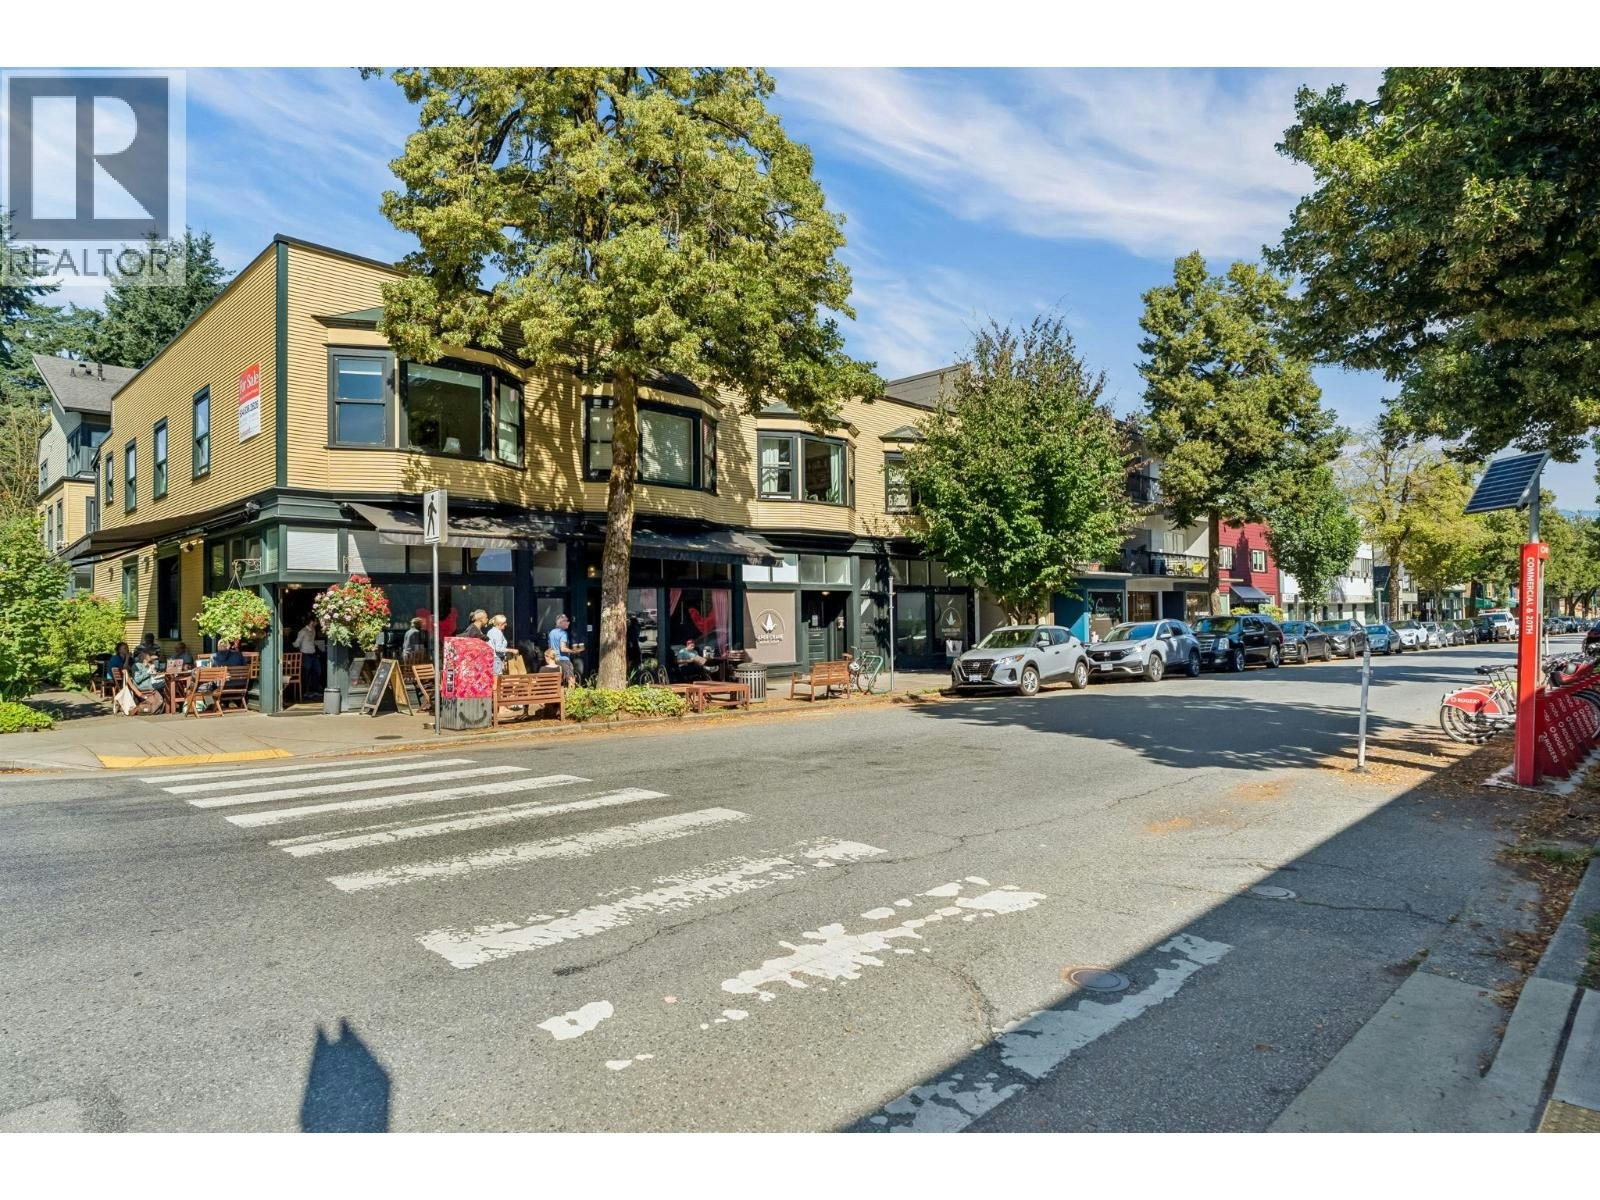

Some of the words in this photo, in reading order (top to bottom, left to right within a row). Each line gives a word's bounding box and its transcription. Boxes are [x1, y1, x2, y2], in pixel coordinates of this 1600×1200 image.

[1526, 557, 1535, 606] COMMERCIAL
[1525, 616, 1534, 635] 20TH
[1544, 738, 1559, 764] ROGERS
